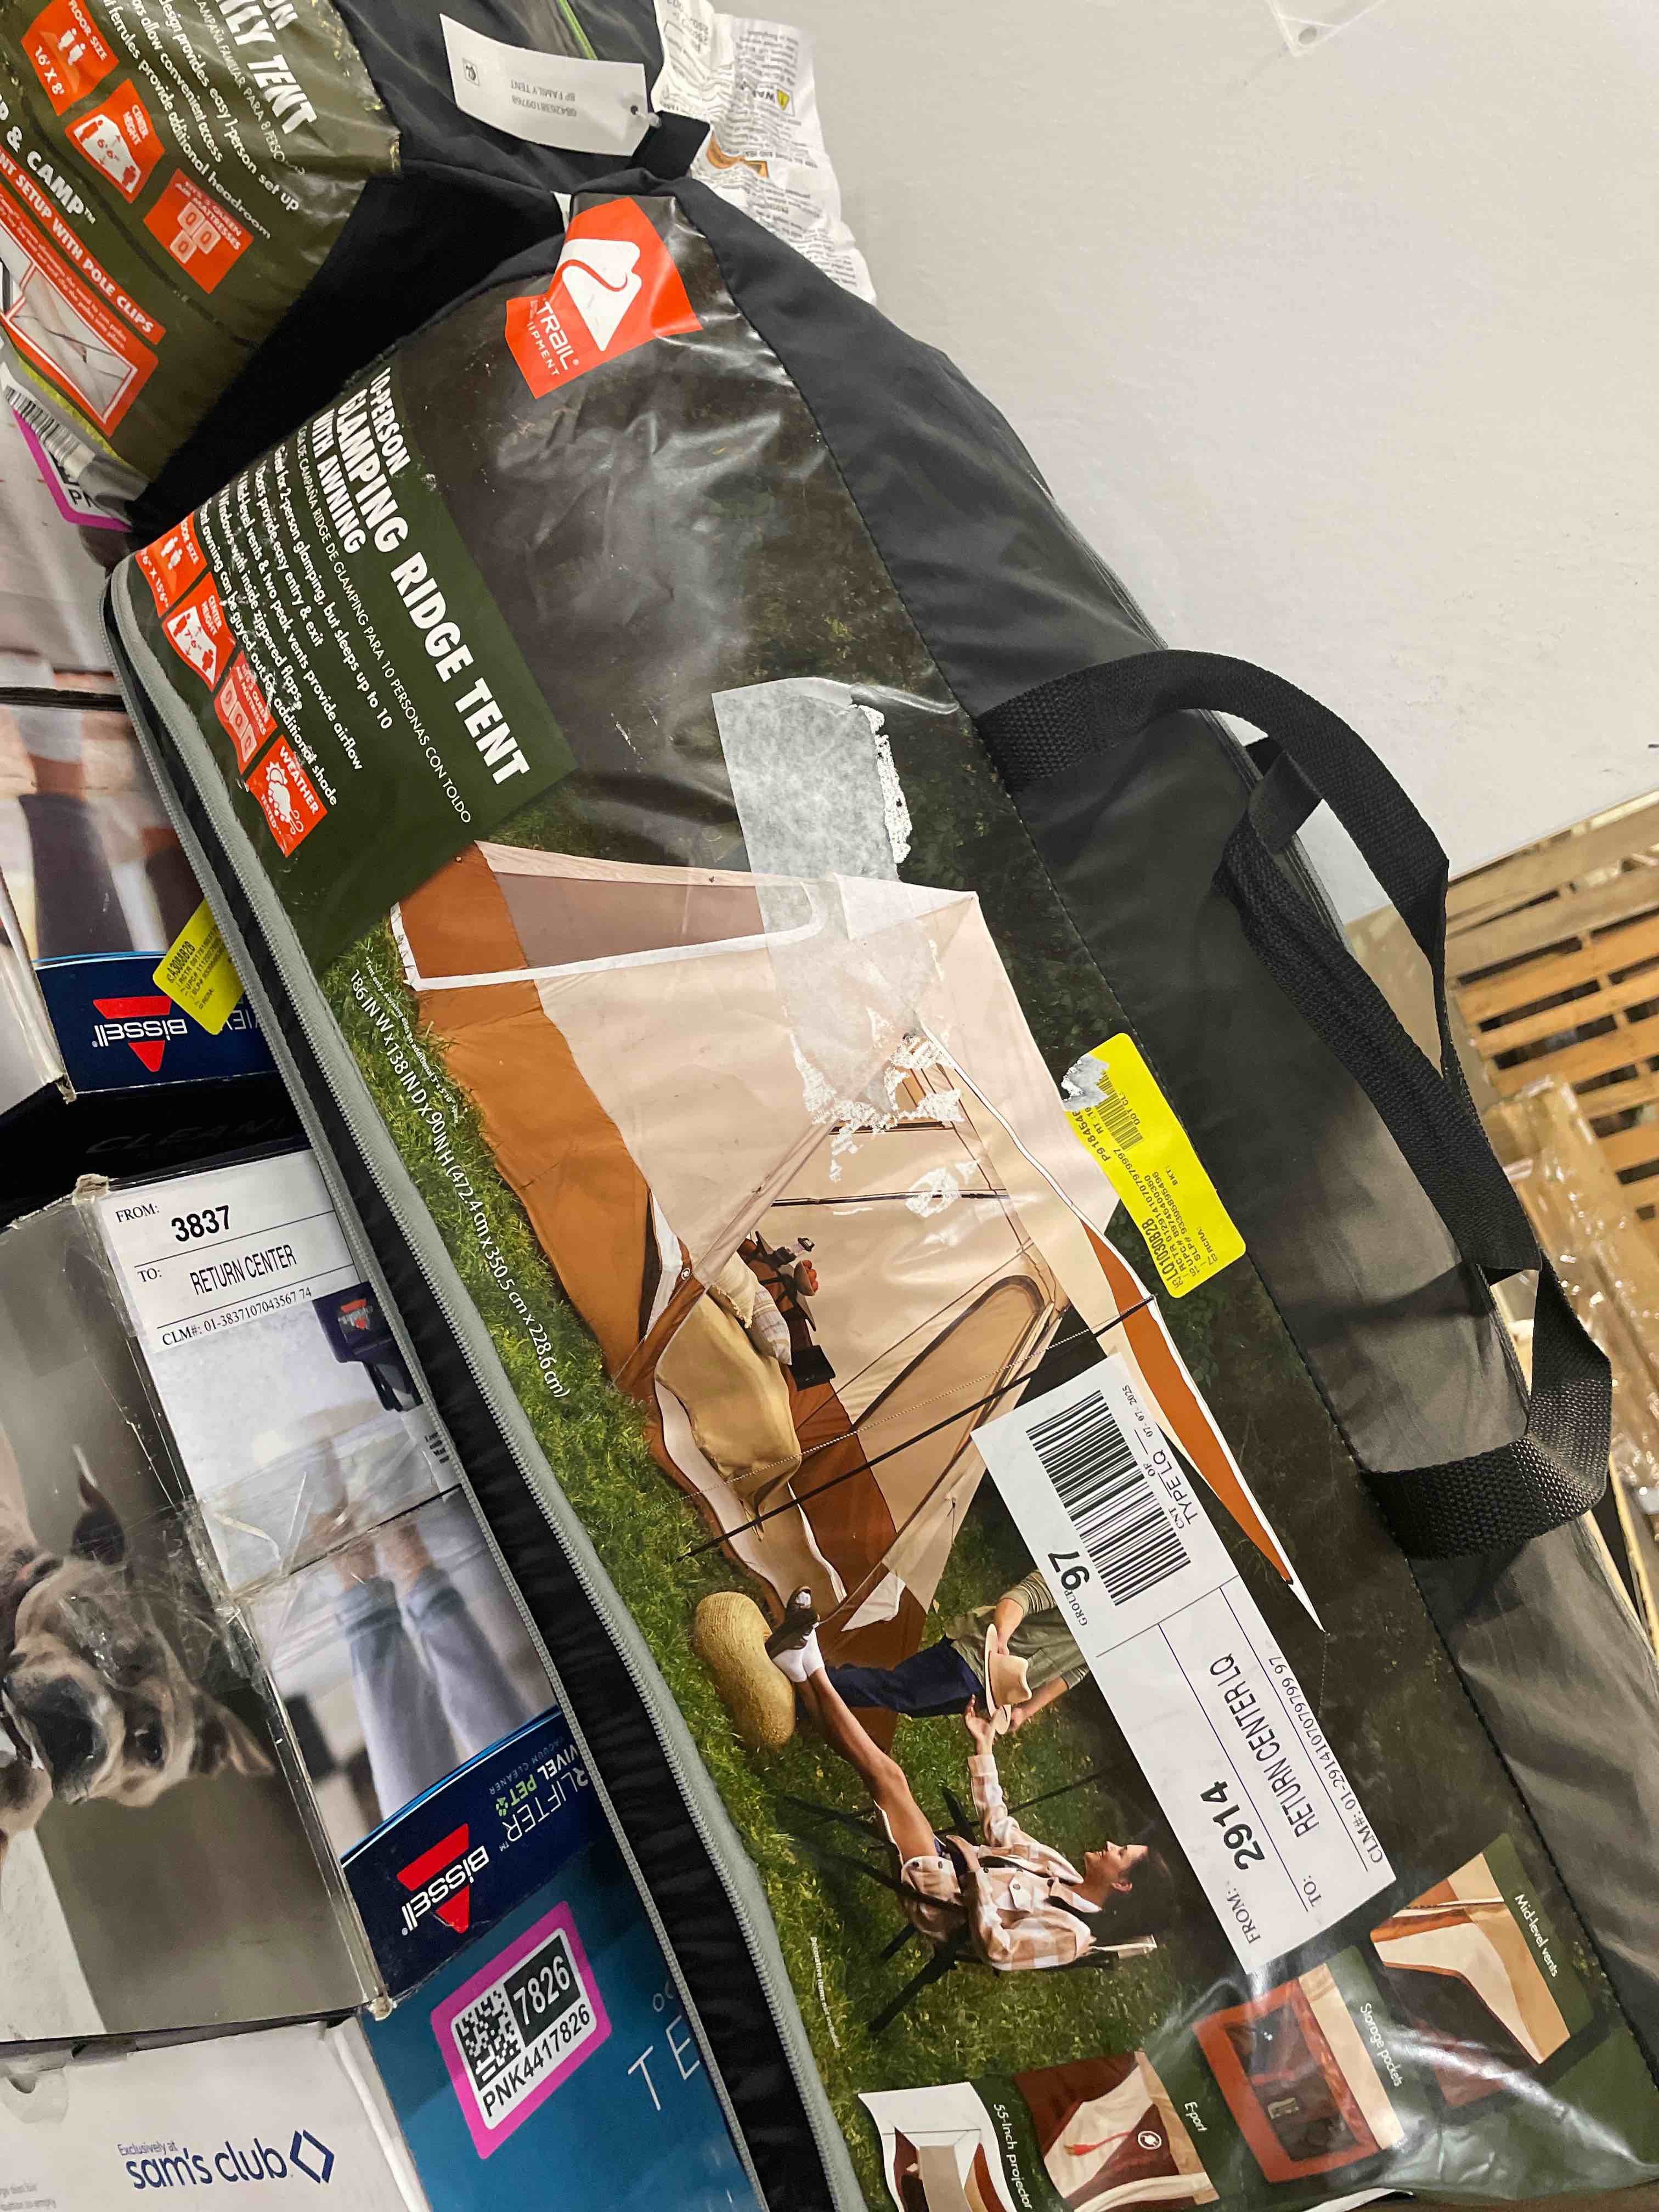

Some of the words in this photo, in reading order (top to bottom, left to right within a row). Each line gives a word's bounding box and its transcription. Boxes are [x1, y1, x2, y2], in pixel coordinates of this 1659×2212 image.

[69, 0, 92, 36] FLOOR
[90, 36, 107, 60] SIZE
[35, 45, 50, 66] 16'
[44, 67, 58, 82] X
[52, 82, 65, 94] 8'
[511, 80, 531, 93] TENT
[140, 17, 163, 50] allow
[160, 53, 207, 127] convenient
[198, 122, 223, 162] access
[243, 87, 264, 122] PARA
[247, 54, 317, 134] TENT
[532, 86, 563, 101] FAMILY
[108, 2, 140, 59] ferrules
[138, 59, 174, 111] provide
[168, 111, 210, 175] additional
[207, 171, 270, 239] headroom
[122, 111, 141, 145] HEIGHT
[132, 105, 149, 139] CENTER
[172, 32, 210, 87] provides
[210, 88, 232, 119] easy
[224, 118, 257, 174] 1-person
[258, 174, 287, 195] set
[280, 193, 300, 211] up
[7, 126, 22, 153] &
[15, 174, 52, 218] SETUP
[52, 221, 83, 261] WITH
[83, 257, 116, 296] POLE
[116, 296, 154, 332] CLIPS
[312, 408, 335, 459] WITH
[370, 367, 411, 476] 10-PERSON
[276, 470, 289, 490] for
[237, 479, 256, 529] Mid-level
[280, 487, 301, 540] 2-person
[317, 454, 366, 554] AWNING
[202, 526, 224, 573] awning
[246, 527, 262, 561] vents
[220, 571, 232, 595] can
[256, 497, 280, 543] provide
[273, 541, 290, 571] easy
[285, 572, 304, 606] entry
[300, 606, 312, 620] &
[306, 621, 324, 647] exit
[258, 560, 269, 574] &
[293, 541, 326, 605] glamping,
[218, 493, 238, 545] Windows
[231, 544, 247, 573] with
[241, 569, 261, 610] inside
[252, 610, 288, 668] zippered
[280, 664, 302, 706] flaps
[227, 590, 242, 611] be
[263, 572, 277, 599] two
[337, 388, 408, 552] GLAMPING
[390, 551, 474, 682] RIDGE
[455, 677, 531, 785] TENT
[208, 595, 222, 629] CENTER
[270, 599, 294, 634] peak
[323, 601, 341, 629] but
[230, 612, 257, 652] guyed
[299, 458, 318, 510] CAMPAÑA
[312, 507, 331, 544] RIDGE
[325, 542, 339, 561] DE
[334, 561, 369, 625] GLAMPING
[363, 625, 385, 661] PARA
[381, 660, 395, 678] 10
[390, 678, 430, 746] PERSONAS
[425, 747, 447, 779] CON
[443, 777, 471, 823] TOLDO
[251, 652, 266, 679] out
[287, 632, 309, 669] vents
[334, 629, 359, 672] sleeps
[303, 669, 336, 721] provide
[356, 672, 370, 691] up
[366, 691, 379, 708] to
[274, 697, 318, 765] additional
[376, 708, 393, 729] 10
[334, 723, 363, 769] airflow
[280, 746, 319, 814] WEATHER
[312, 765, 337, 805] shade
[351, 969, 369, 1001] 186
[361, 996, 381, 1017] IN
[375, 1012, 394, 1032] W
[383, 1032, 394, 1046] x
[386, 1042, 409, 1074] 138
[411, 1043, 436, 1078] additional
[400, 1070, 420, 1092] IN
[411, 1088, 427, 1104] D
[416, 1102, 433, 1117] x
[425, 1111, 445, 1134] 90
[433, 1131, 450, 1153] IN
[437, 1149, 455, 1167] H
[443, 1165, 483, 1211] (472.4
[116, 1203, 160, 1223] FROM:
[171, 1205, 229, 1242] 3837
[473, 1212, 489, 1237] cm
[479, 1235, 493, 1250] x
[1169, 1243, 1187, 1272] RCTR
[137, 1268, 162, 1282] TO:
[189, 1259, 246, 1295] RETURN
[245, 1244, 297, 1278] CENTER
[484, 1246, 515, 1290] 350.5
[162, 1326, 202, 1345] CLM#:
[204, 1291, 296, 1331] 01-3837107043567
[298, 1286, 312, 1299] 74
[509, 1291, 527, 1314] cm
[522, 1313, 535, 1325] x
[528, 1323, 557, 1369] 228.6
[544, 1370, 571, 1397] cm)
[1122, 1385, 1137, 1406] 2025
[1143, 1463, 1156, 1477] OF
[1153, 1449, 1172, 1475] LQ
[1166, 1476, 1198, 1525] TYPE
[1168, 1507, 1184, 1529] CNT
[1047, 1551, 1090, 1595] 97
[1064, 1586, 1088, 1626] GROUP
[1210, 1653, 1241, 1687] LQ
[1268, 1650, 1289, 1674] 97
[1224, 1680, 1280, 1762] CENTER
[1282, 1670, 1361, 1810] 01-2914107079799
[489, 1762, 529, 1795] CLEANER
[509, 1774, 537, 1807] PET
[1263, 1757, 1319, 1838] RETURN
[1200, 1781, 1265, 1870] 2914
[1355, 1807, 1389, 1863] CLM#:
[1303, 1875, 1322, 1907] TO:
[1227, 1888, 1261, 1944] FROM:
[1514, 1894, 1549, 1948] Mid-level
[1542, 1947, 1558, 1977] vents
[513, 1955, 579, 2025] 7826
[482, 2004, 590, 2118] PNK4417826
[1360, 2003, 1390, 2049] Storage
[1375, 2046, 1403, 2086] pockets
[1184, 2101, 1207, 2131] E-port
[117, 2141, 167, 2157] Exclusively
[167, 2141, 178, 2152] at
[126, 2147, 213, 2190] sam's
[215, 2137, 287, 2182] club
[994, 2104, 1018, 2149] 55-Inch
[1006, 2154, 1033, 2209] projector
